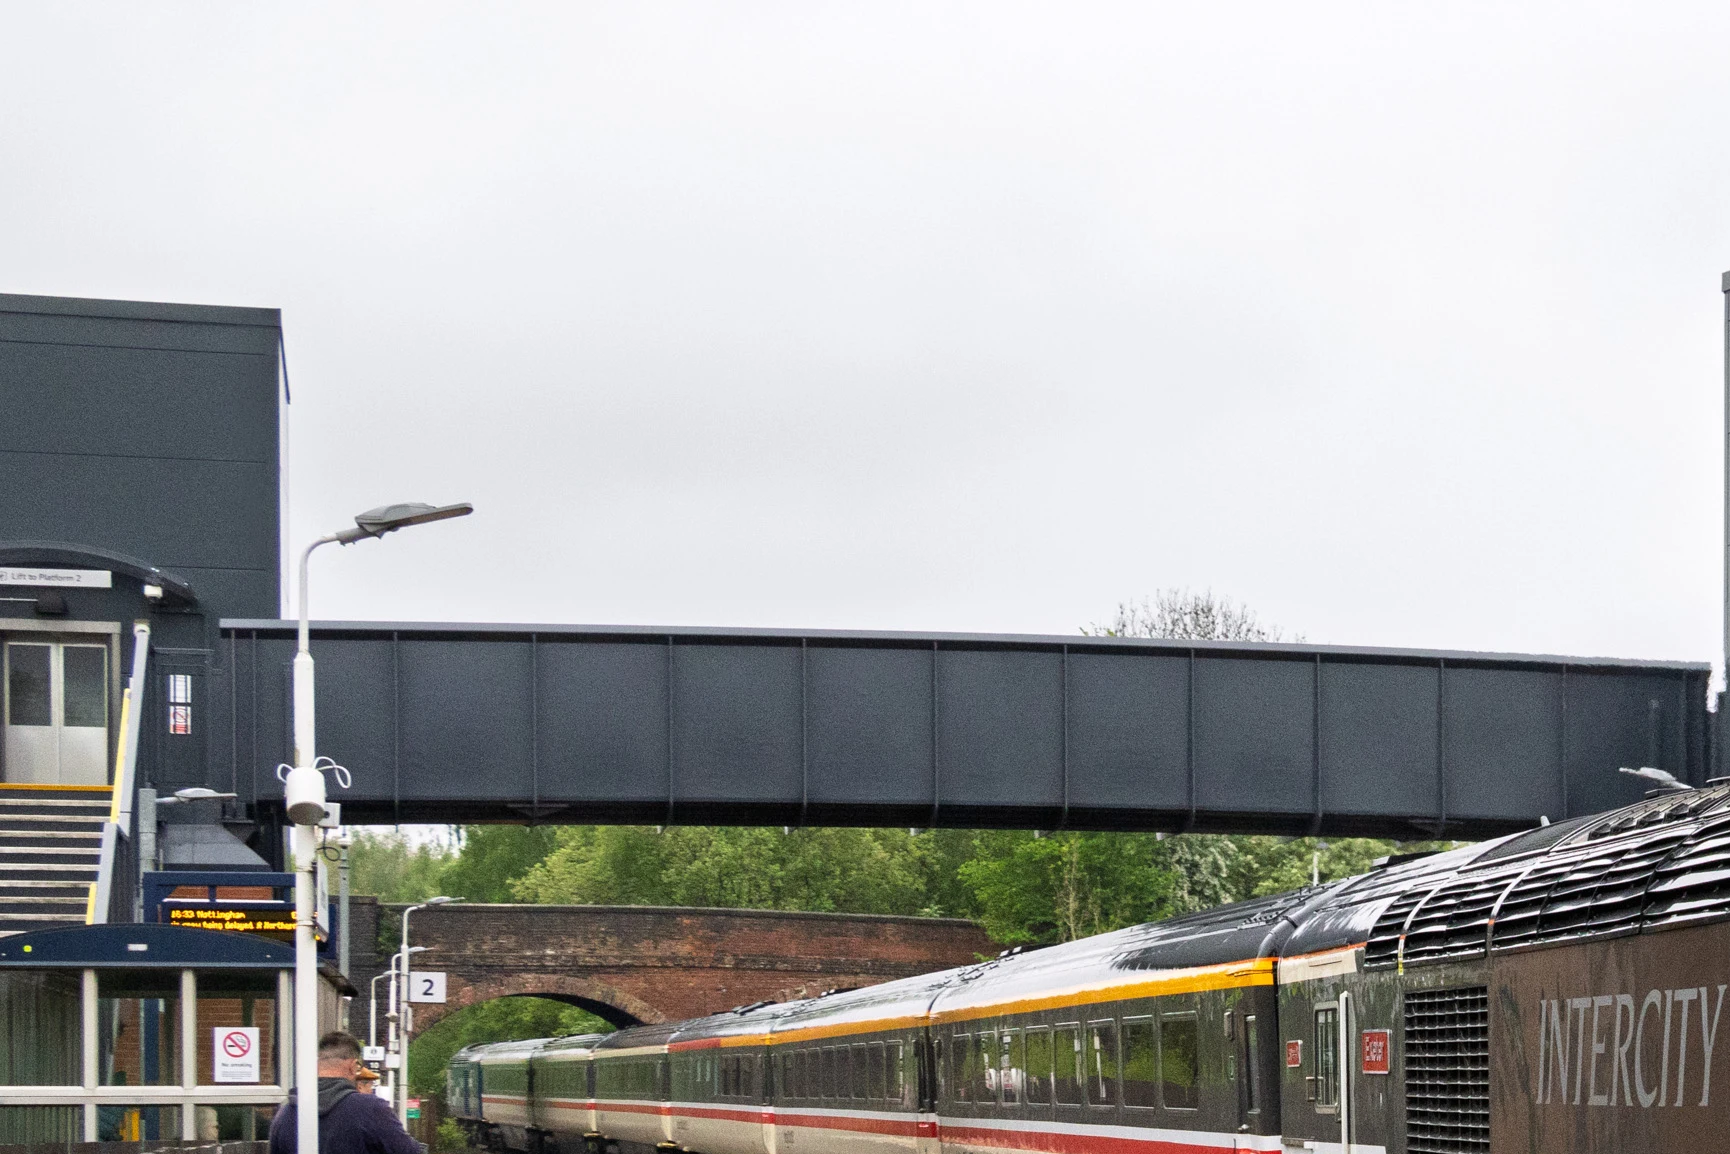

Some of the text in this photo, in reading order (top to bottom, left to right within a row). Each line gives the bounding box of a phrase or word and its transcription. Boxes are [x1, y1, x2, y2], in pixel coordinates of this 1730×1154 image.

[39, 573, 74, 582] Platform
[76, 574, 82, 582] 2
[196, 910, 246, 920] Nottingham
[422, 978, 434, 996] 2
[1536, 984, 1728, 1108] INTERCITY
